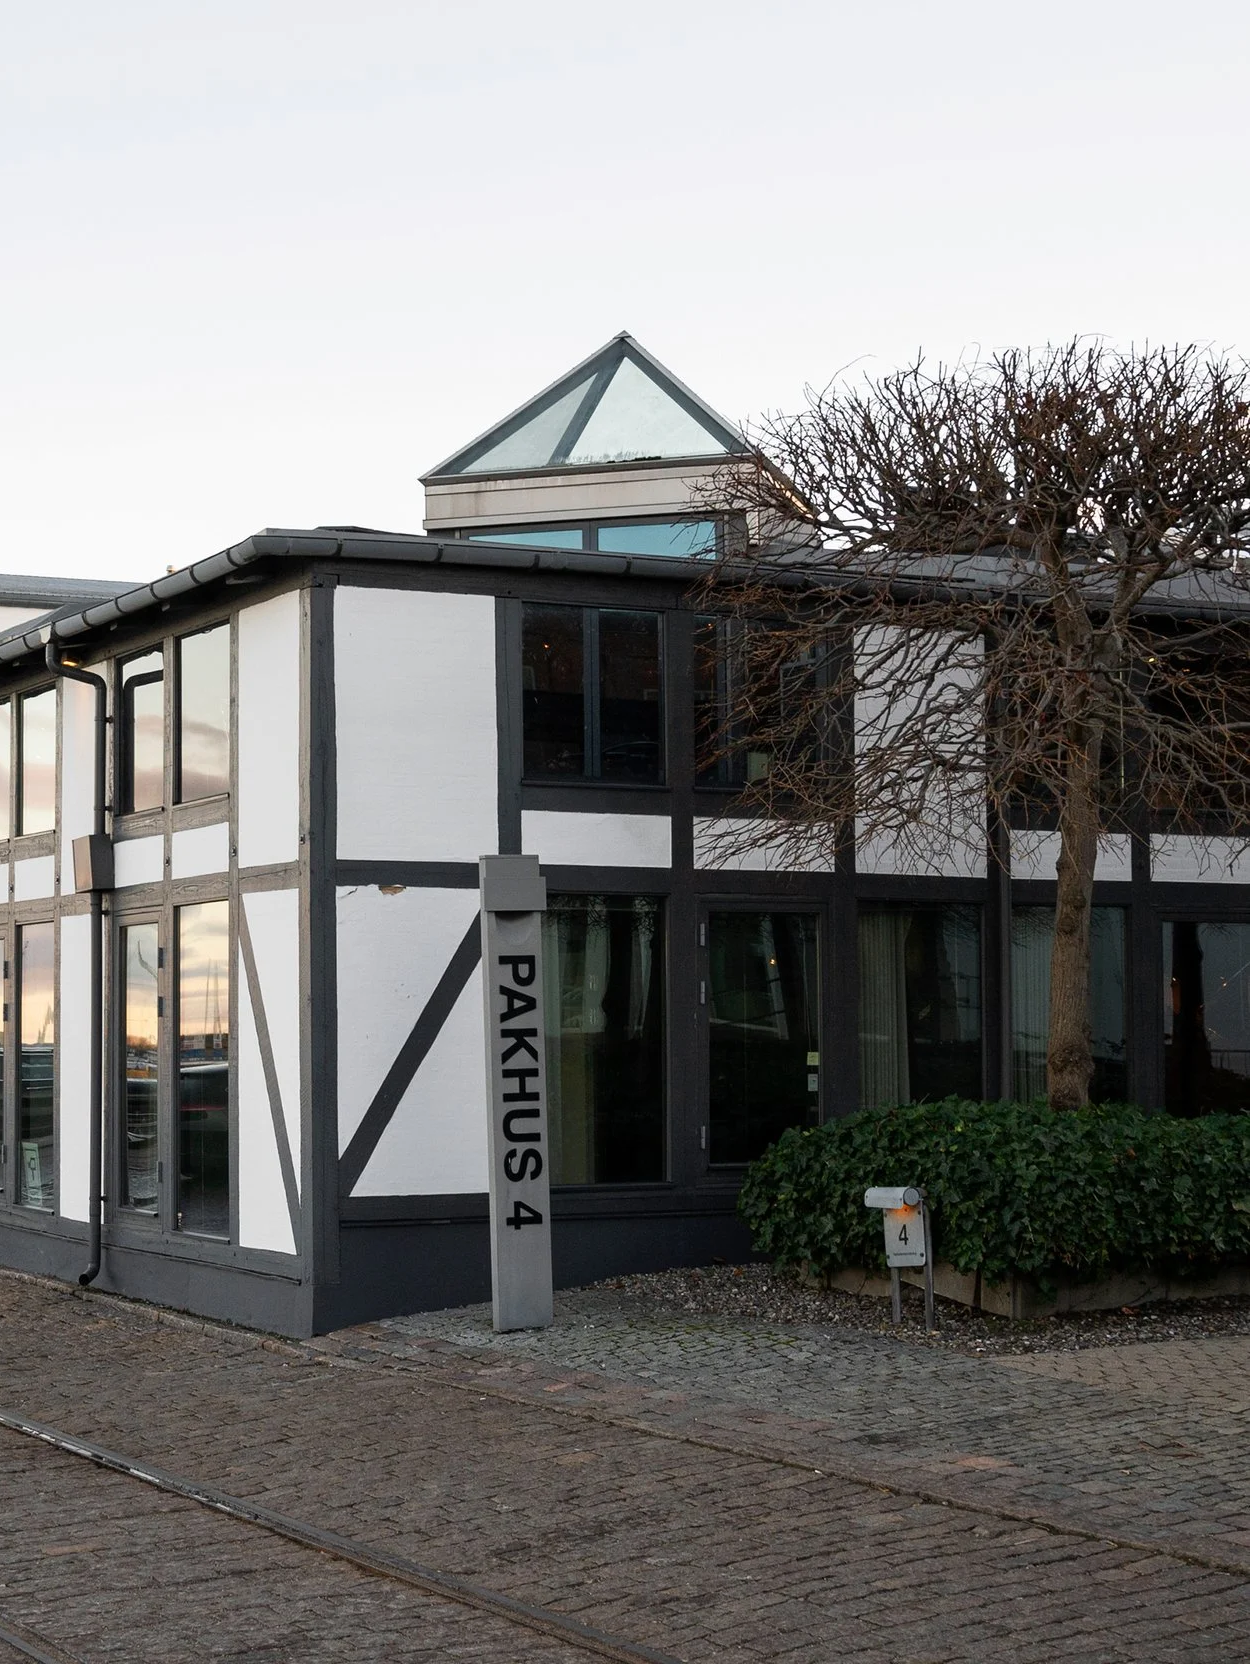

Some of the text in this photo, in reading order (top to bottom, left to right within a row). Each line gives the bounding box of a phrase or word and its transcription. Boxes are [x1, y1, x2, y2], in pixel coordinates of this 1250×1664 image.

[498, 955, 543, 1230] PAKHUS 4
[898, 1224, 909, 1245] 4
